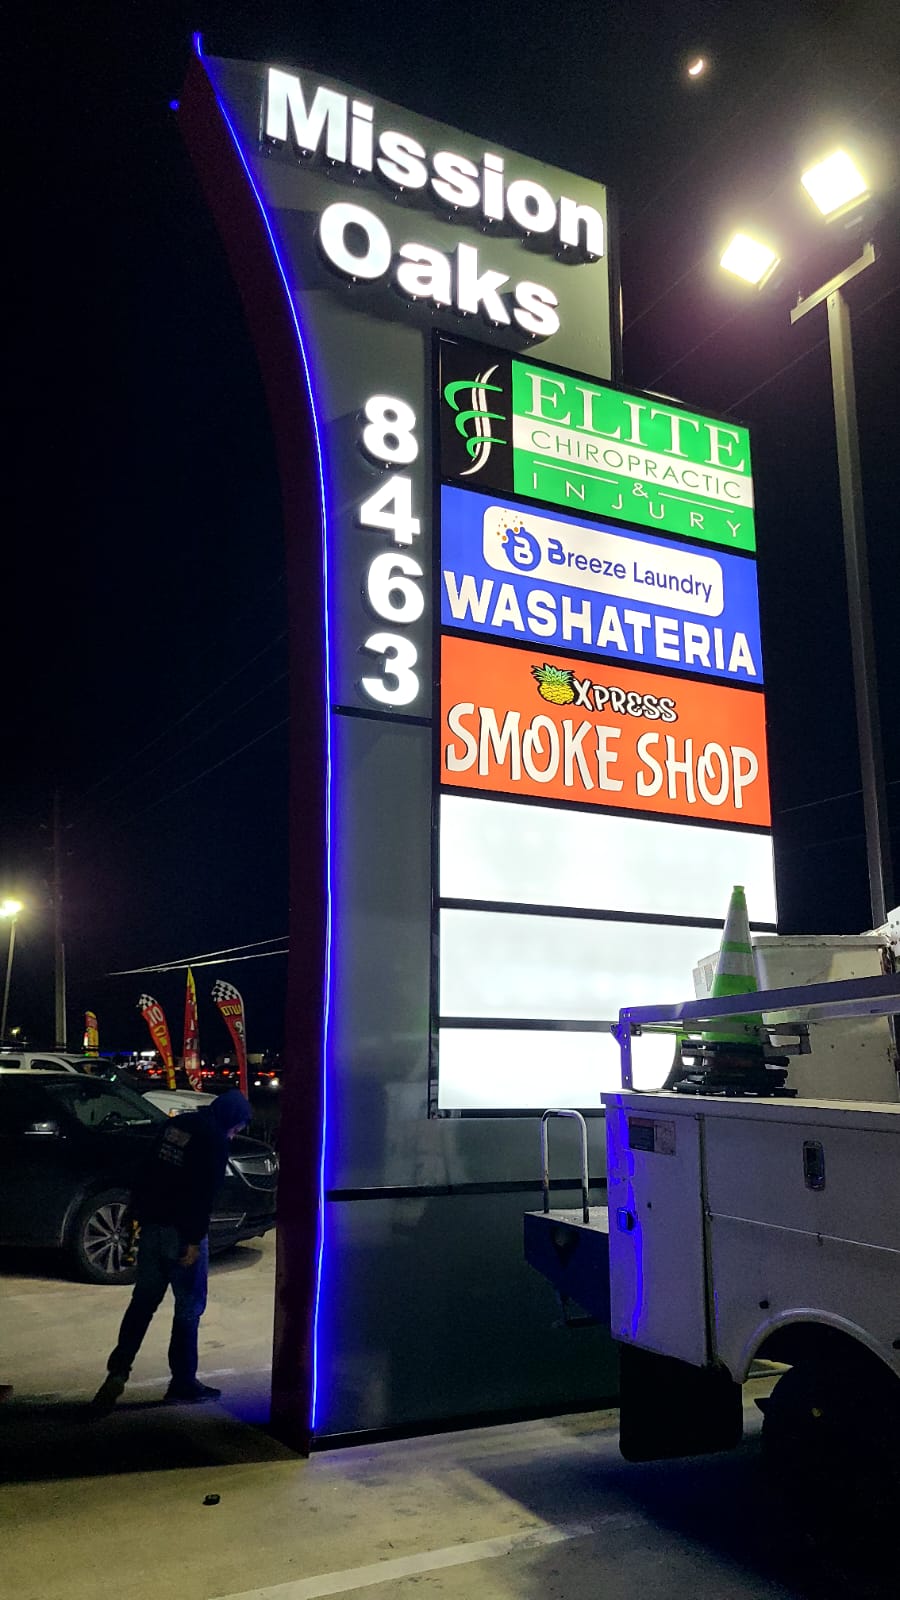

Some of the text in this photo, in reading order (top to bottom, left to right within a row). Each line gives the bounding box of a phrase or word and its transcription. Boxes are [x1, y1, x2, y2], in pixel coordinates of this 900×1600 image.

[266, 67, 604, 257] Mission
[318, 202, 561, 337] Oaks
[525, 372, 745, 472] ELITE
[531, 430, 741, 499] CHIROPRACTIC
[532, 472, 741, 538] INJURY
[631, 482, 649, 498] &
[361, 394, 425, 706] 8463
[547, 537, 713, 603] Breeze Laundry
[443, 570, 757, 676] WASHATERIA
[573, 678, 678, 723] XPRESS
[446, 702, 759, 809] SMOKE SHOP
